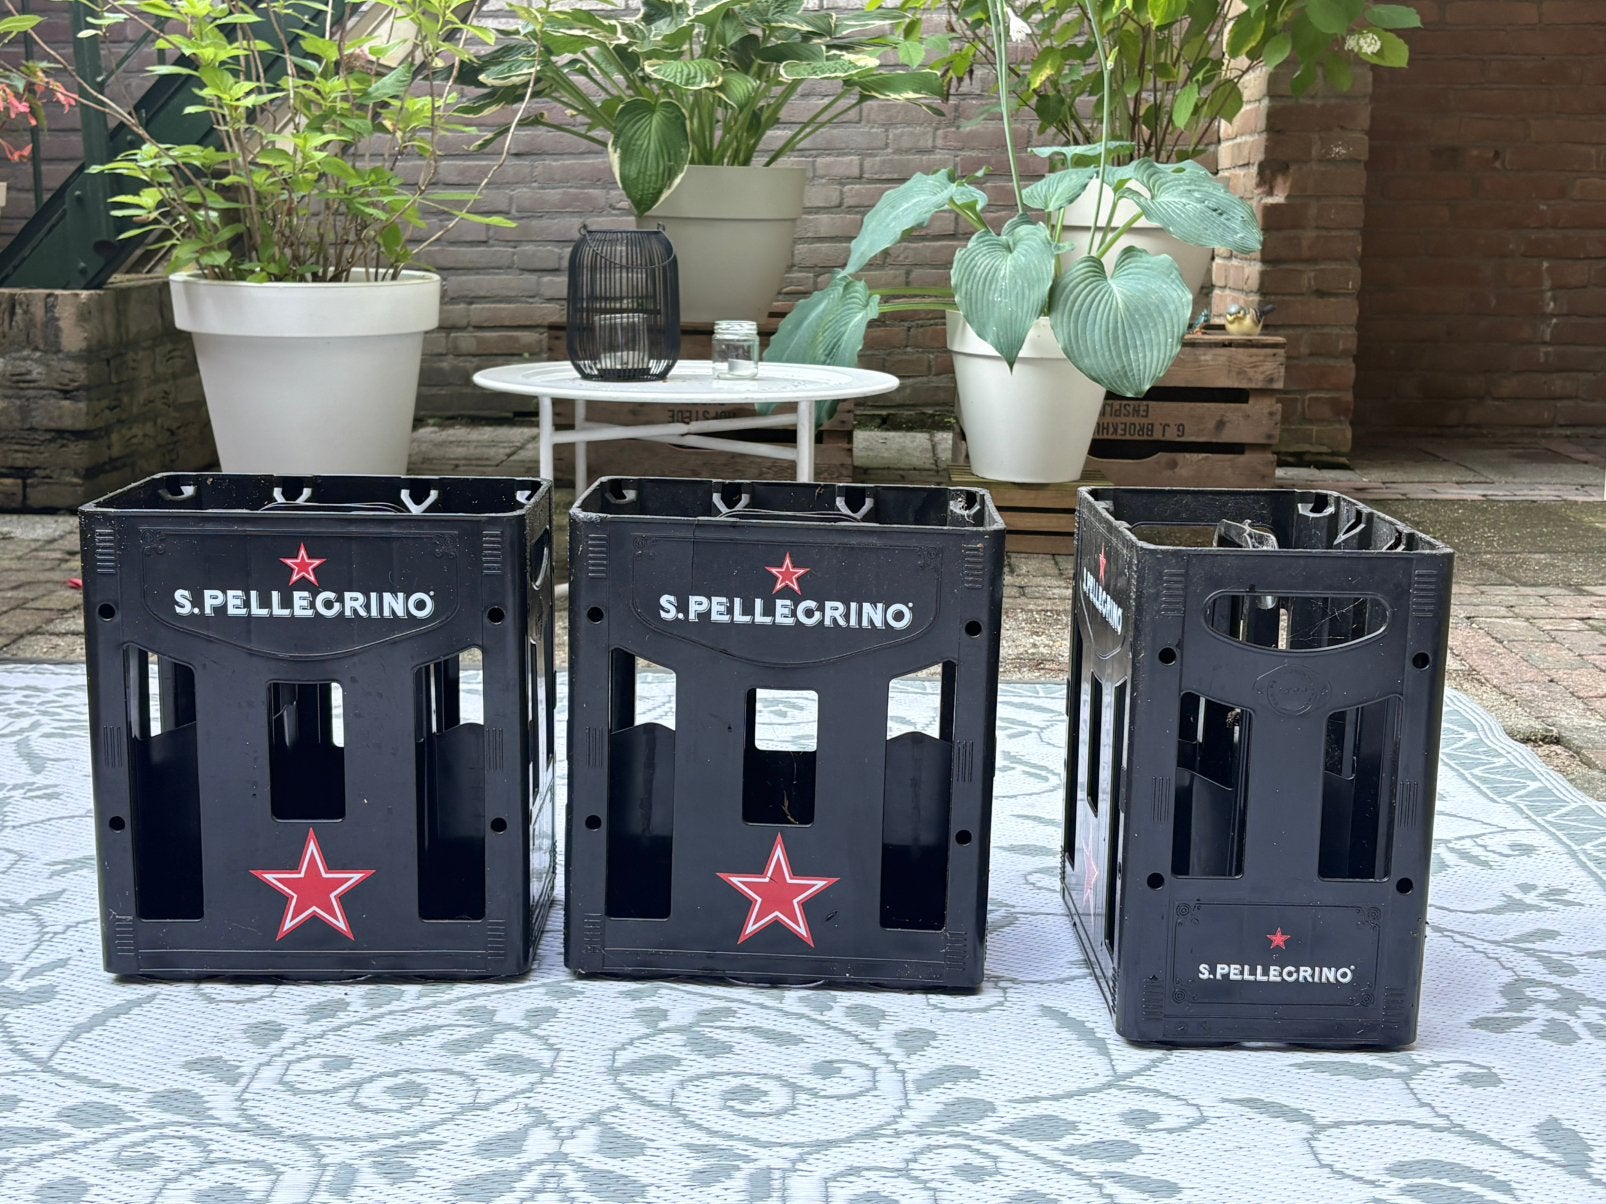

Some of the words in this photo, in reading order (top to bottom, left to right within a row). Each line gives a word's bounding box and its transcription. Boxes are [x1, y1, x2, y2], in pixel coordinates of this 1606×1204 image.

[1098, 402, 1150, 419] ENSPIJ
[1160, 423, 1172, 438] J.
[1174, 423, 1185, 438] G.
